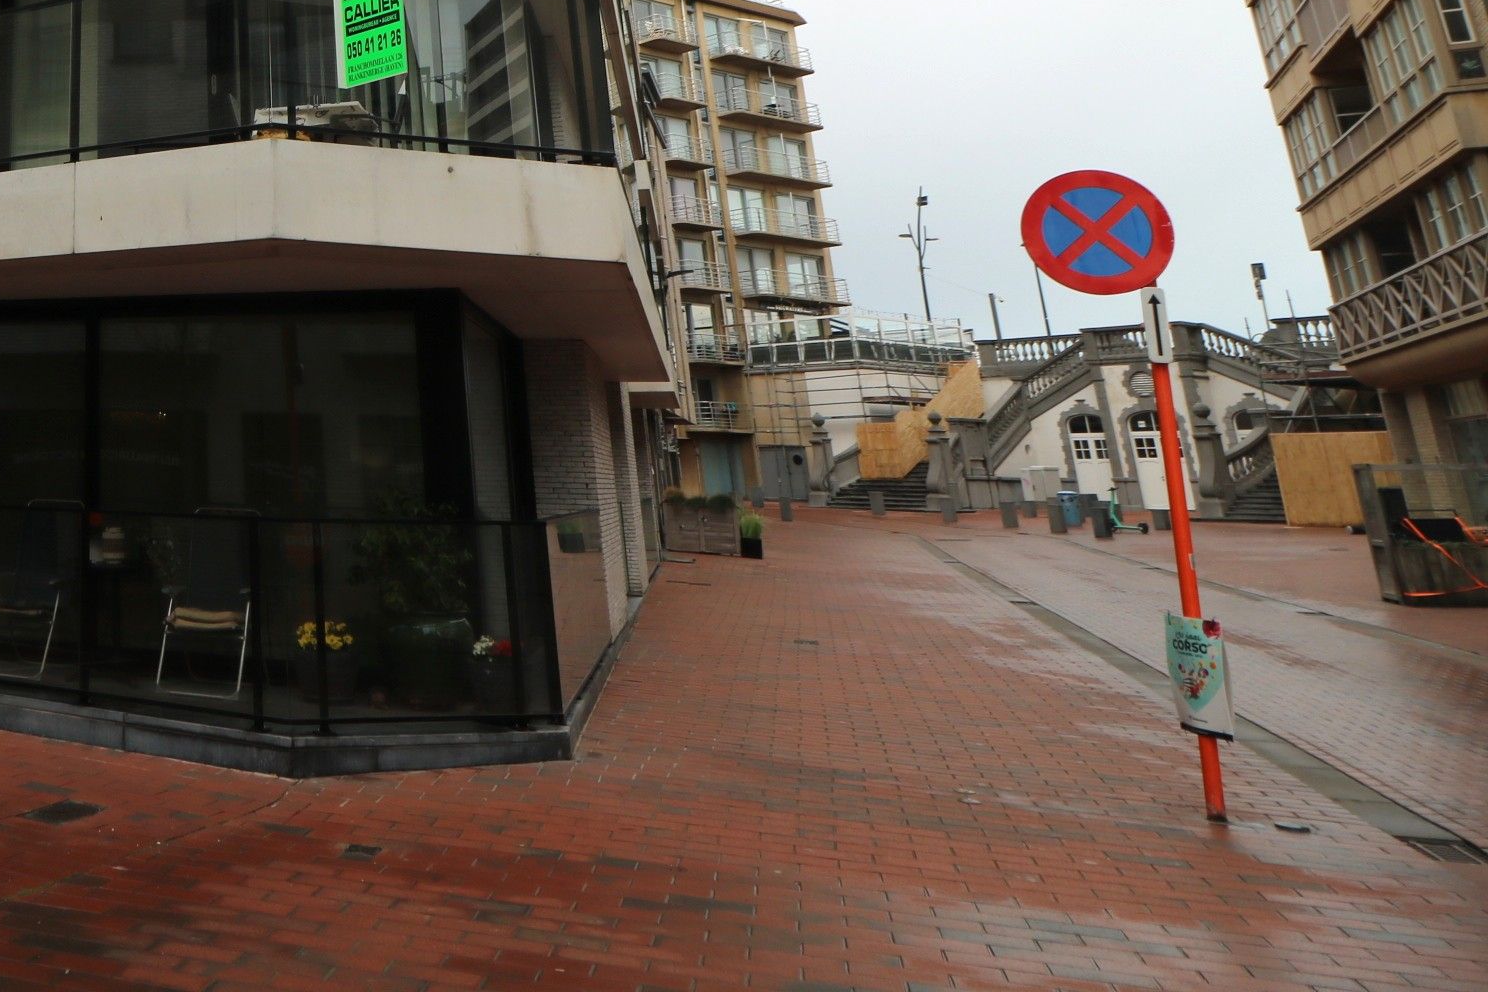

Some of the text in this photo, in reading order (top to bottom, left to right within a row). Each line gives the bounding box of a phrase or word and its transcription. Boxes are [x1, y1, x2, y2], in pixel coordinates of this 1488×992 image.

[382, 13, 398, 24] AGENCE
[347, 28, 402, 60] 050 41 21 26
[1172, 639, 1207, 654] CORSO
